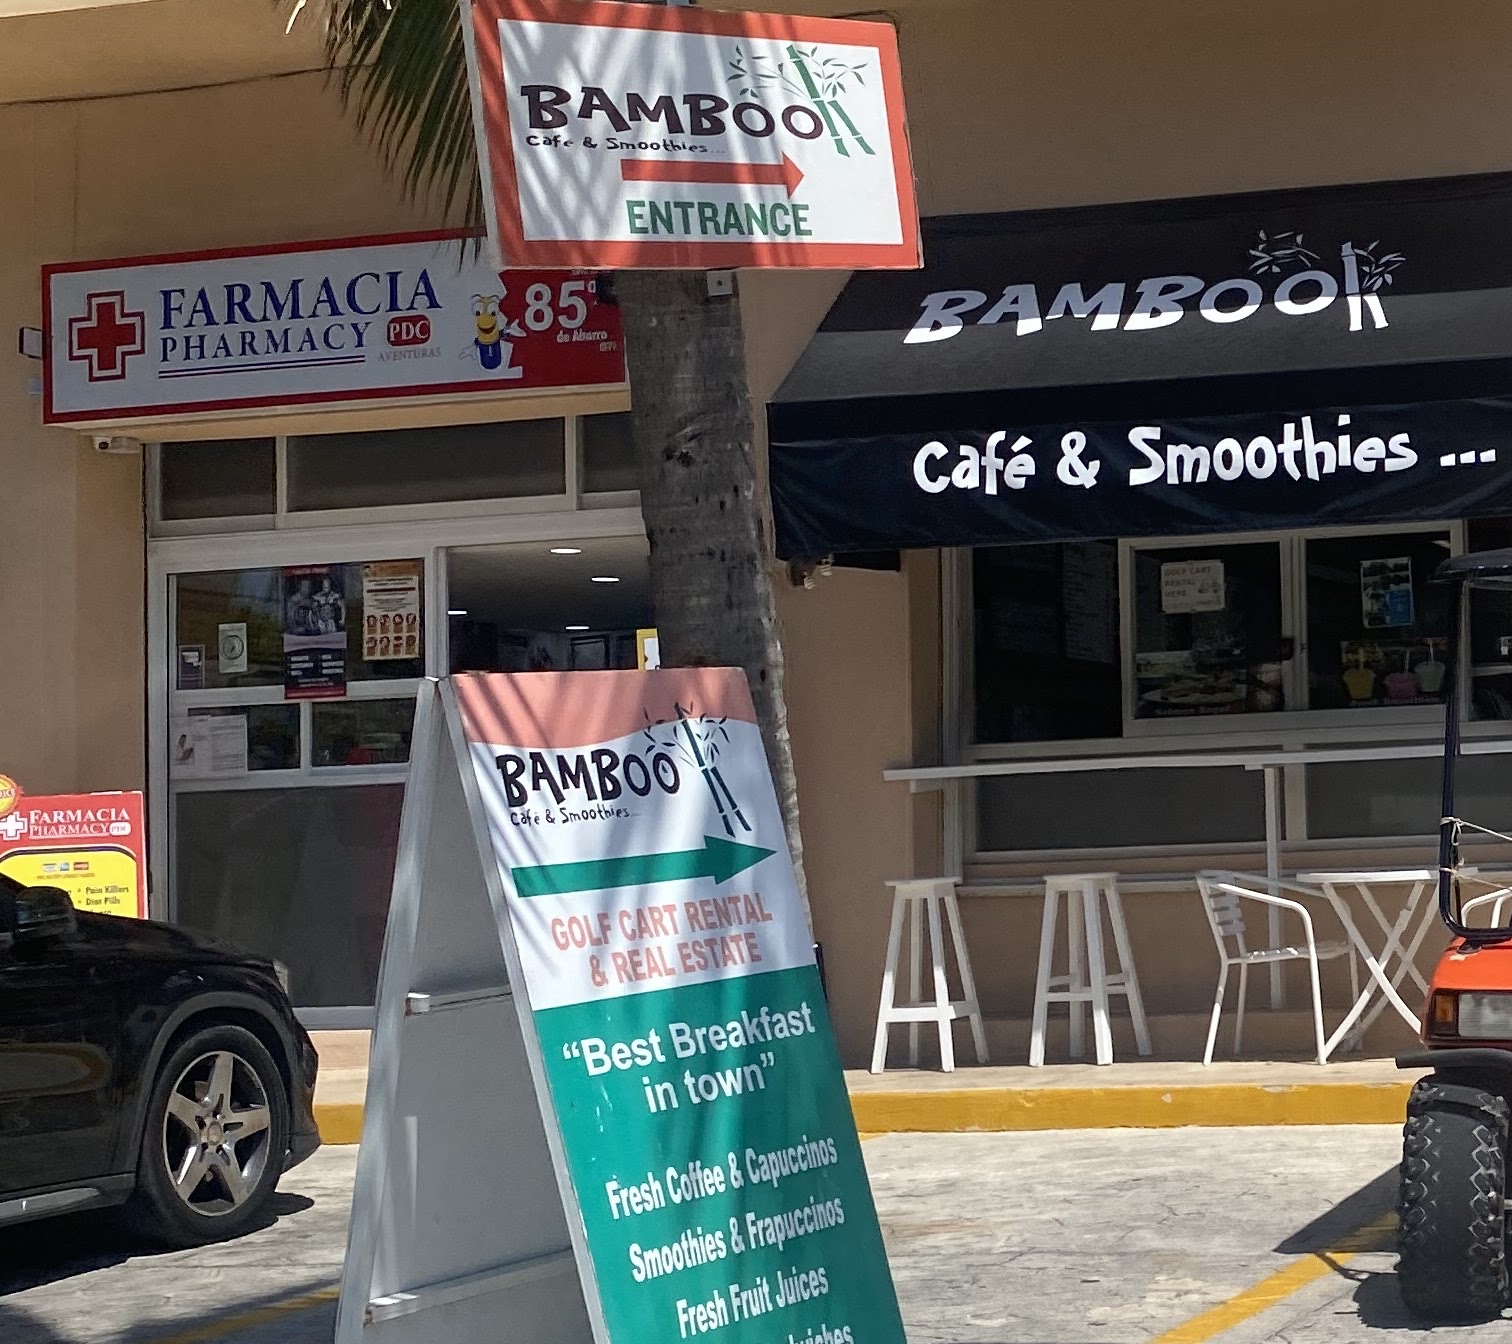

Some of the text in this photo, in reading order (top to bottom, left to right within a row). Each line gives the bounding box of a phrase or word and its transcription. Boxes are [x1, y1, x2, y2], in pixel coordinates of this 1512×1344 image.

[520, 84, 824, 140] BAMBOO
[582, 136, 597, 149] &
[626, 199, 813, 237] ENTRANCE
[159, 268, 443, 331] FARMACIA
[903, 270, 1339, 344] BAMBOO
[160, 321, 373, 363] PHARMACY
[388, 320, 430, 341] PDC
[913, 430, 1036, 495] Café
[1056, 431, 1101, 489] &
[1128, 414, 1418, 486] Smoothies
[496, 748, 680, 808] BAMBOO
[29, 808, 130, 824] FARMACIA
[29, 822, 110, 836] PHARMACY
[545, 809, 555, 824] &
[551, 892, 773, 951] GOLF CART RENTAL
[589, 931, 763, 988] & REAL ESTATE
[562, 1001, 816, 1077] “Best Breakfast
[641, 1051, 775, 1113] in town”
[605, 1134, 838, 1220] Fresh Coffee & Capuccinos
[629, 1195, 845, 1283] Smoothies & Frapuccinos
[676, 1265, 829, 1339] Fresh Fruit Juices
